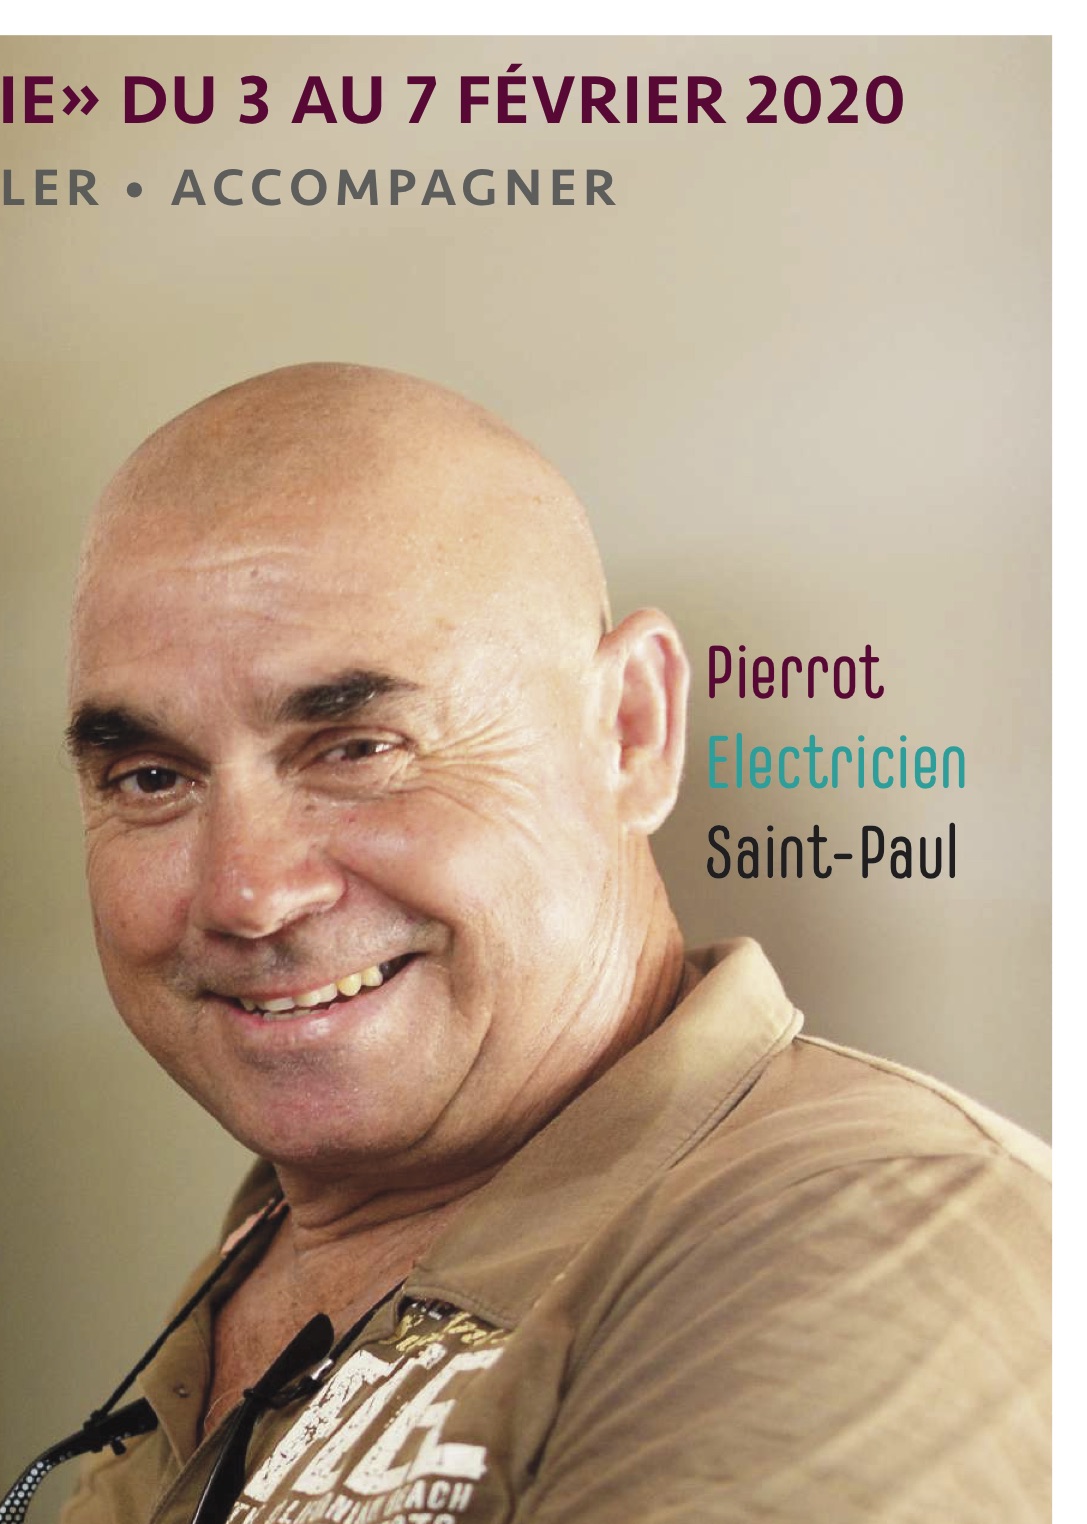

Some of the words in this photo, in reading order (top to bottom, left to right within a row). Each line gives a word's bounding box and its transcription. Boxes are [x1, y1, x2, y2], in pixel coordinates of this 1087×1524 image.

[123, 75, 215, 125] DU
[239, 75, 270, 125] 3
[291, 75, 383, 125] AU
[406, 75, 438, 125] 7
[459, 63, 727, 125] FÉVRIER
[746, 75, 904, 125] 2020
[171, 168, 617, 206] ACCOMPAGNER
[709, 644, 884, 699] Pierrot
[709, 733, 965, 789] Electricien
[707, 823, 956, 879] Saint-Paul
